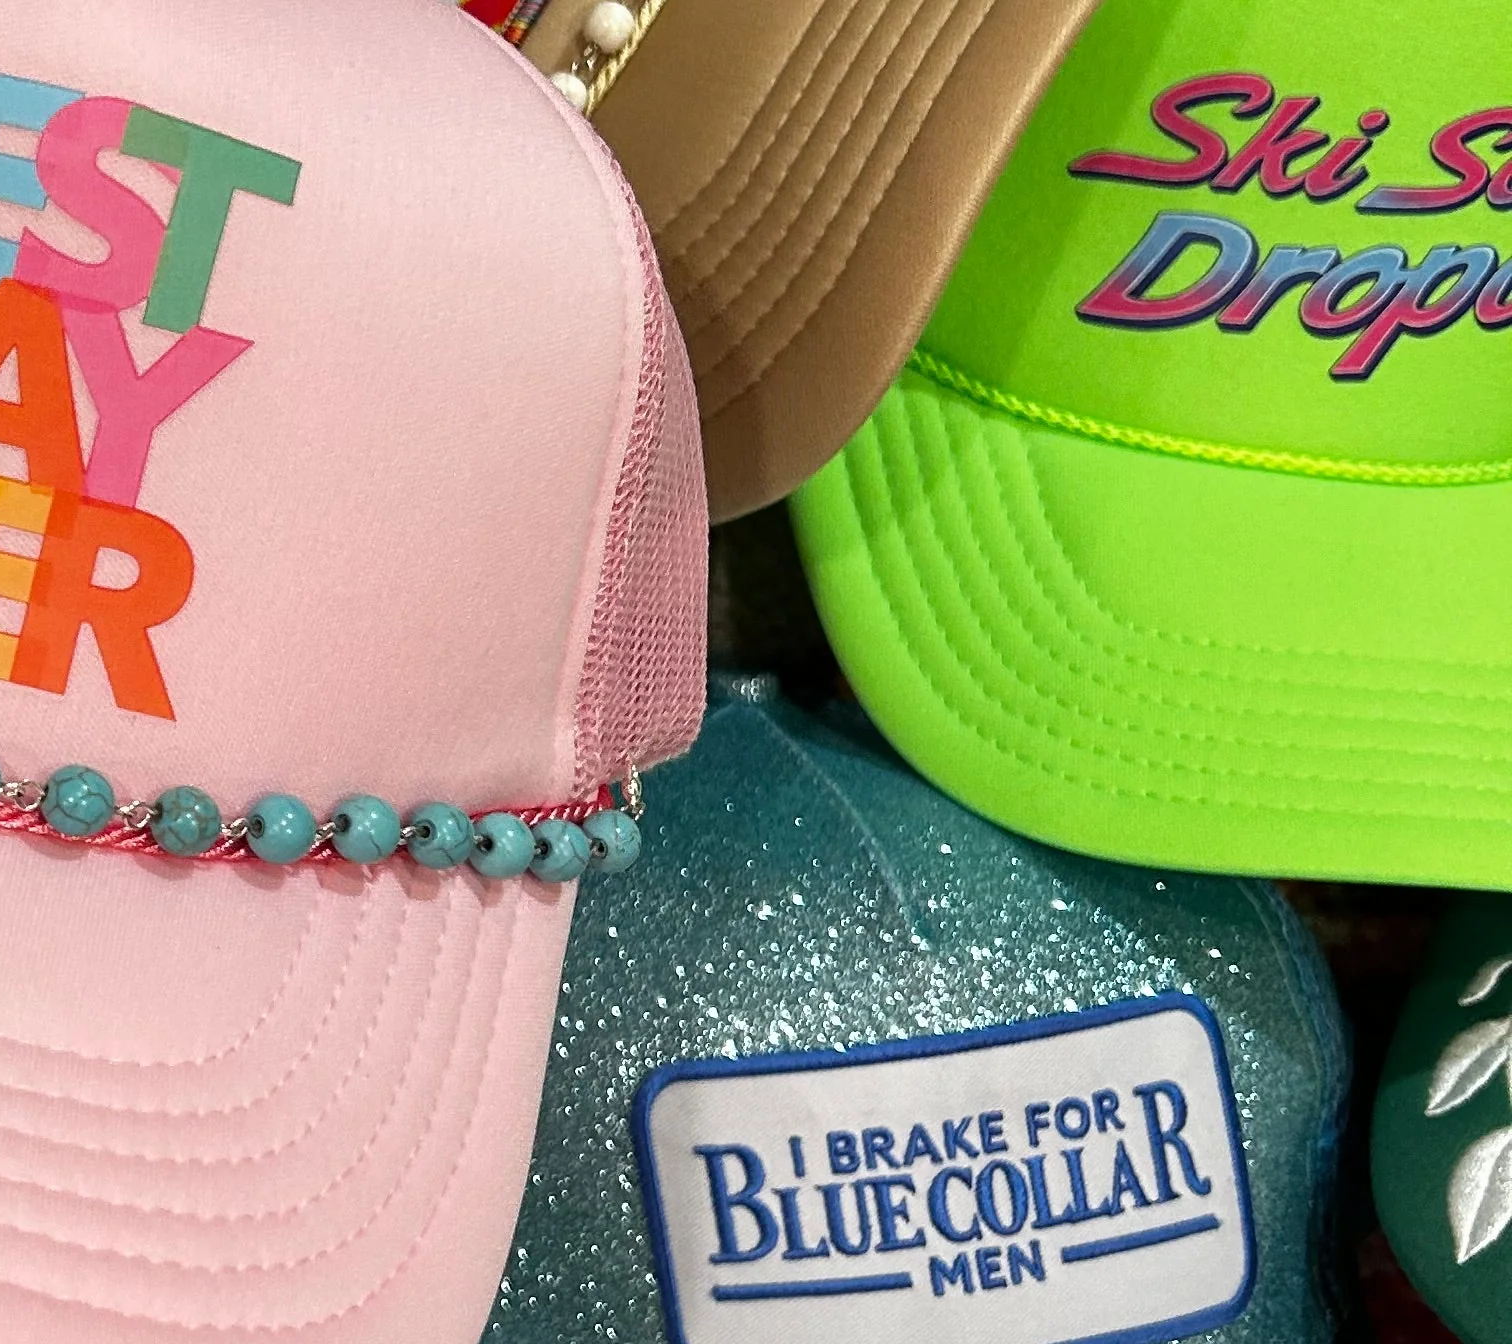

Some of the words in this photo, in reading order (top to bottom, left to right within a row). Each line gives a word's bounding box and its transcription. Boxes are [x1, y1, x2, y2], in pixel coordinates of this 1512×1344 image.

[1068, 72, 1391, 199] Ski
[789, 1136, 805, 1178] I
[826, 1110, 1008, 1174] BRAKE
[1025, 1088, 1125, 1147] FOR
[928, 1238, 1046, 1297] MEN
